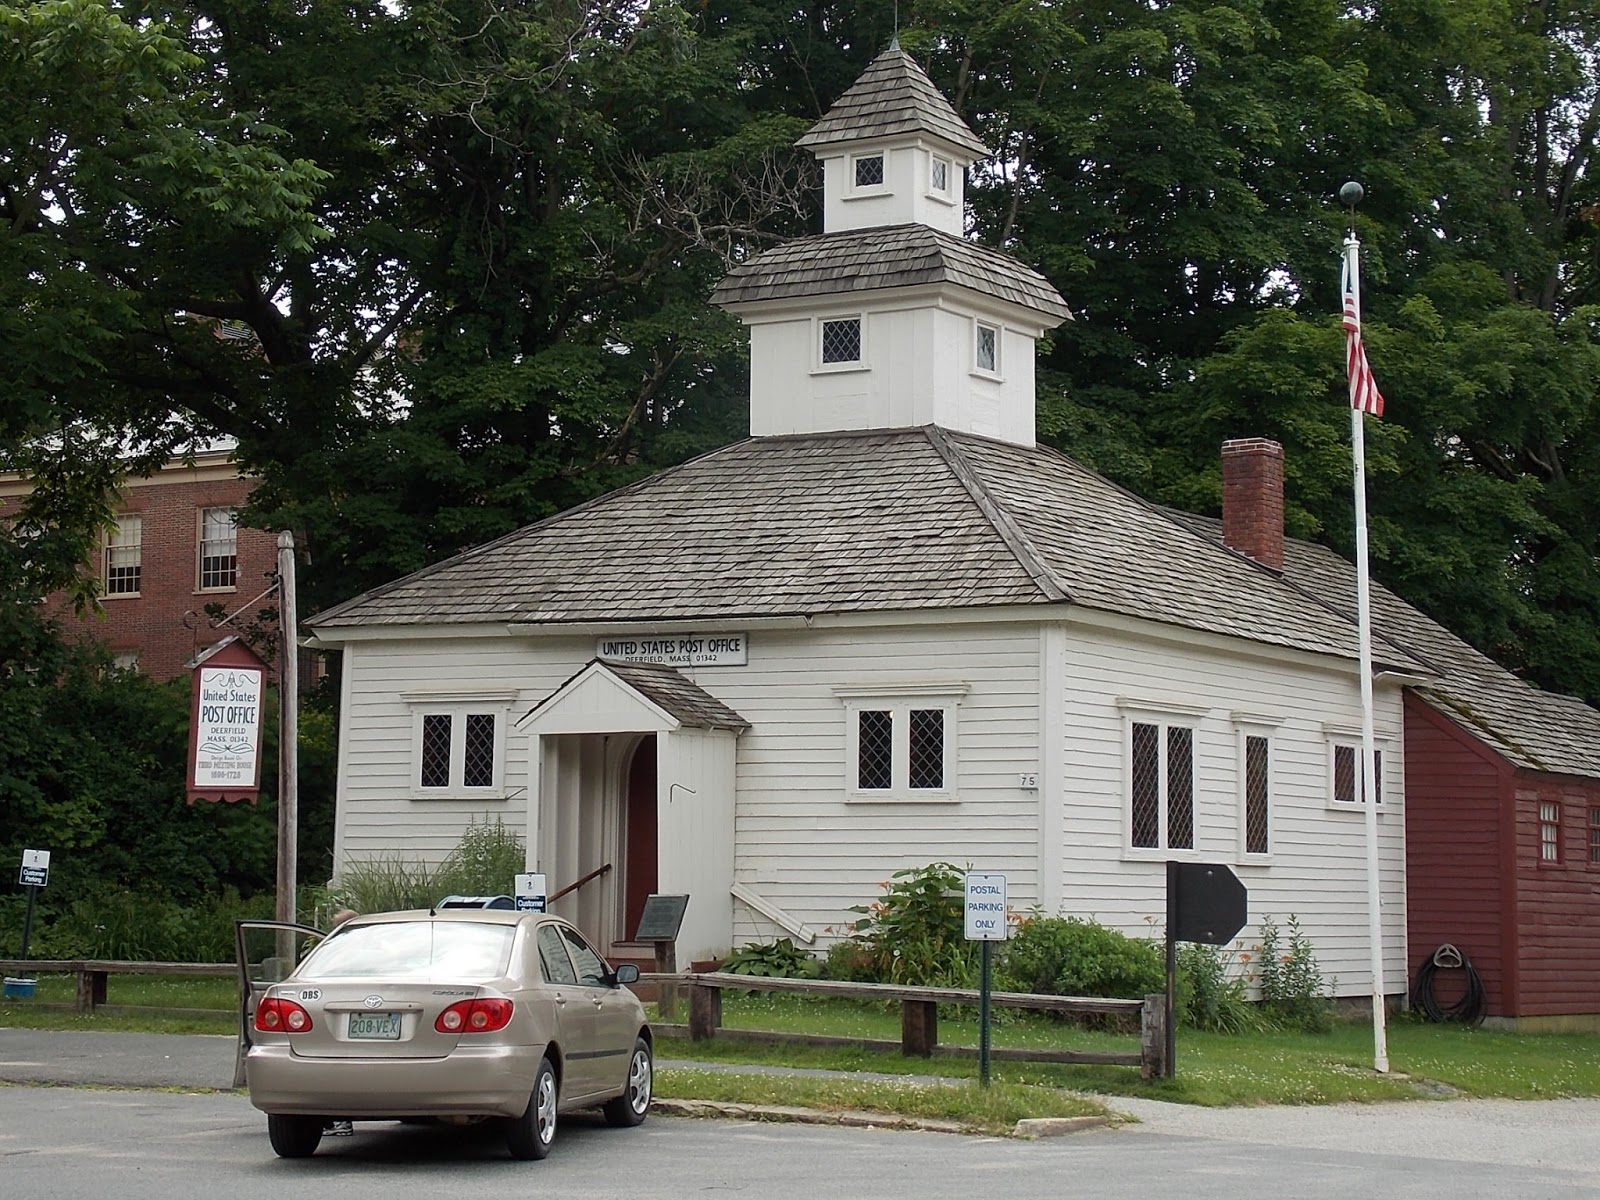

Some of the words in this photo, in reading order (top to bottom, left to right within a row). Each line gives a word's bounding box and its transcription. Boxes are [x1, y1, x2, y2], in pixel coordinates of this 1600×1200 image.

[603, 641, 637, 655] UNITED
[641, 640, 675, 654] STATES
[679, 639, 704, 653] POST
[708, 638, 741, 652] OFFICE
[203, 689, 228, 701] United
[230, 690, 256, 702] States
[202, 705, 225, 723] POST
[227, 706, 255, 723] OFFICE
[970, 885, 1001, 895] POSTAL
[517, 899, 544, 907] Customer
[968, 902, 1004, 912] PARKING
[975, 919, 996, 929] ONLY
